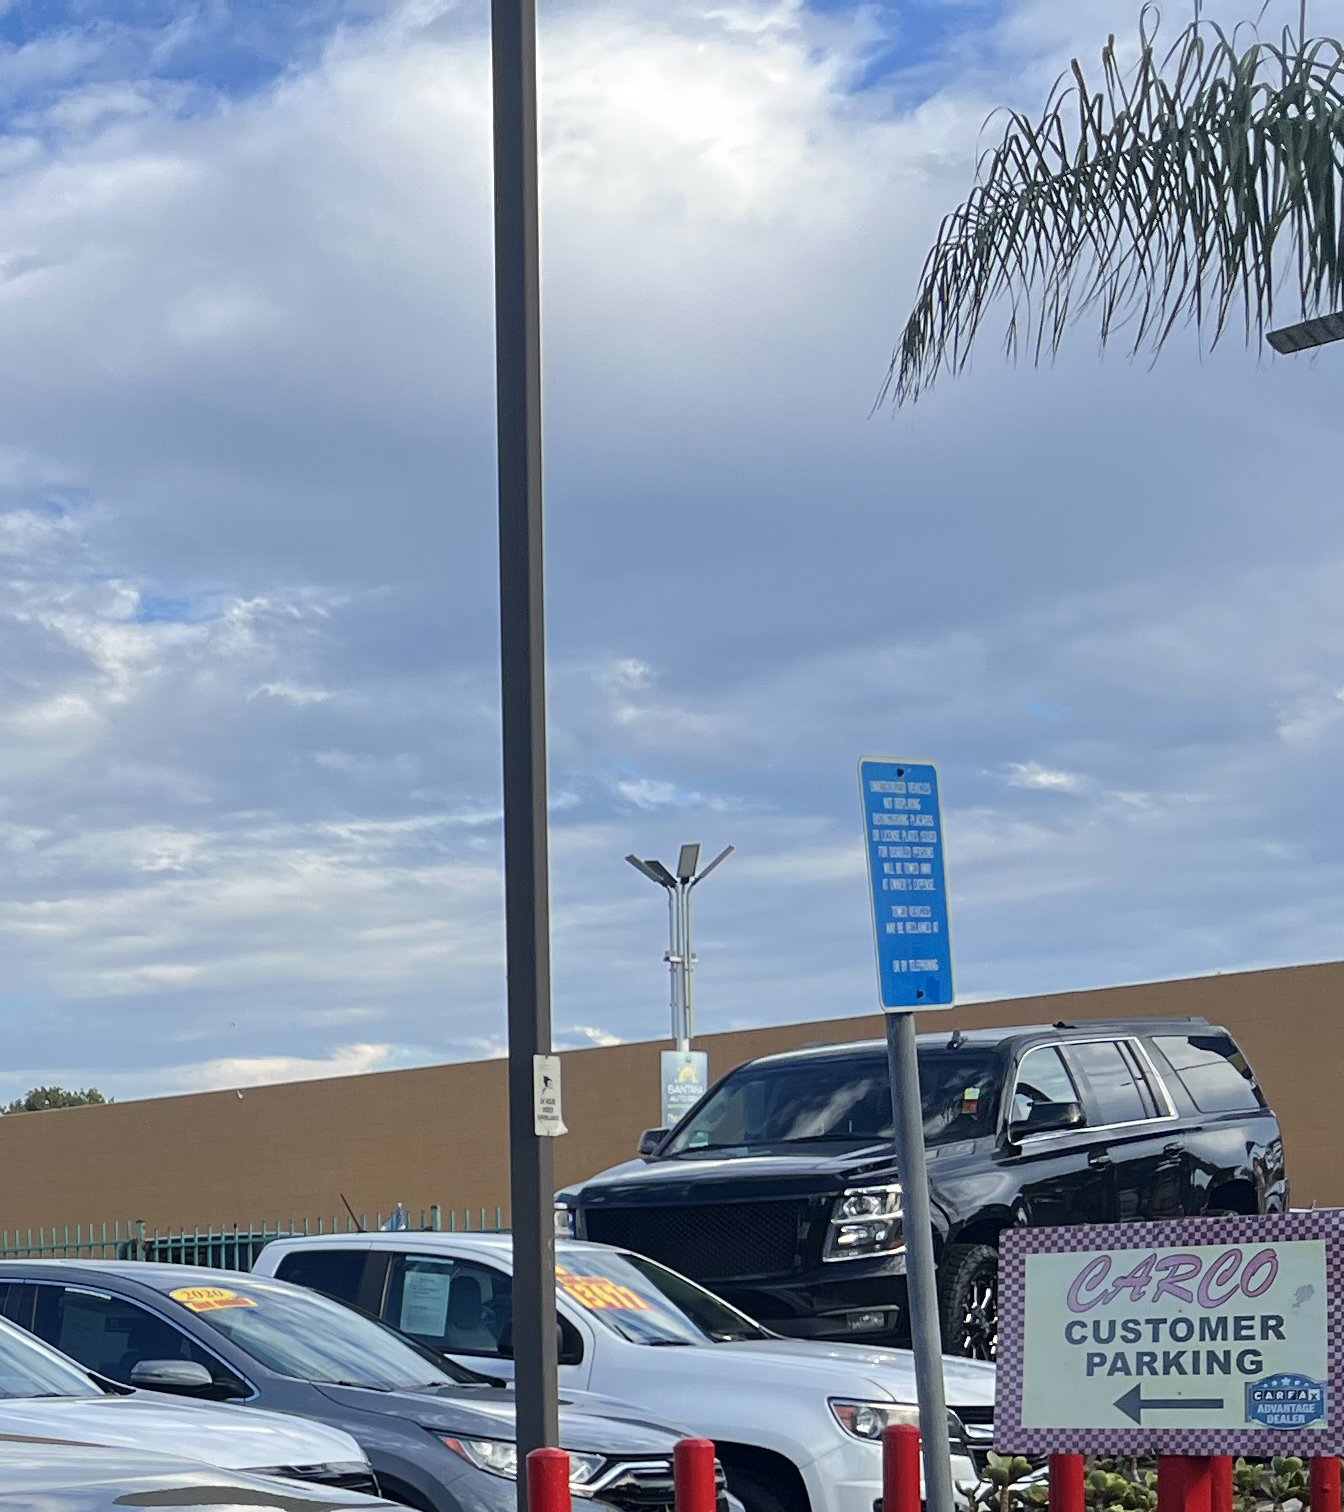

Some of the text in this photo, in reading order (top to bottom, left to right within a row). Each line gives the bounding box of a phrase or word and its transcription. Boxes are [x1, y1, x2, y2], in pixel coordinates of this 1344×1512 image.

[1067, 1248, 1279, 1313] CARCO
[1064, 1314, 1286, 1345] CUSTOMER
[1086, 1349, 1263, 1377] PARKING
[1254, 1389, 1320, 1401] CARFAX
[1257, 1404, 1316, 1413] ADVANTAGE
[1266, 1414, 1305, 1424] DEALER
